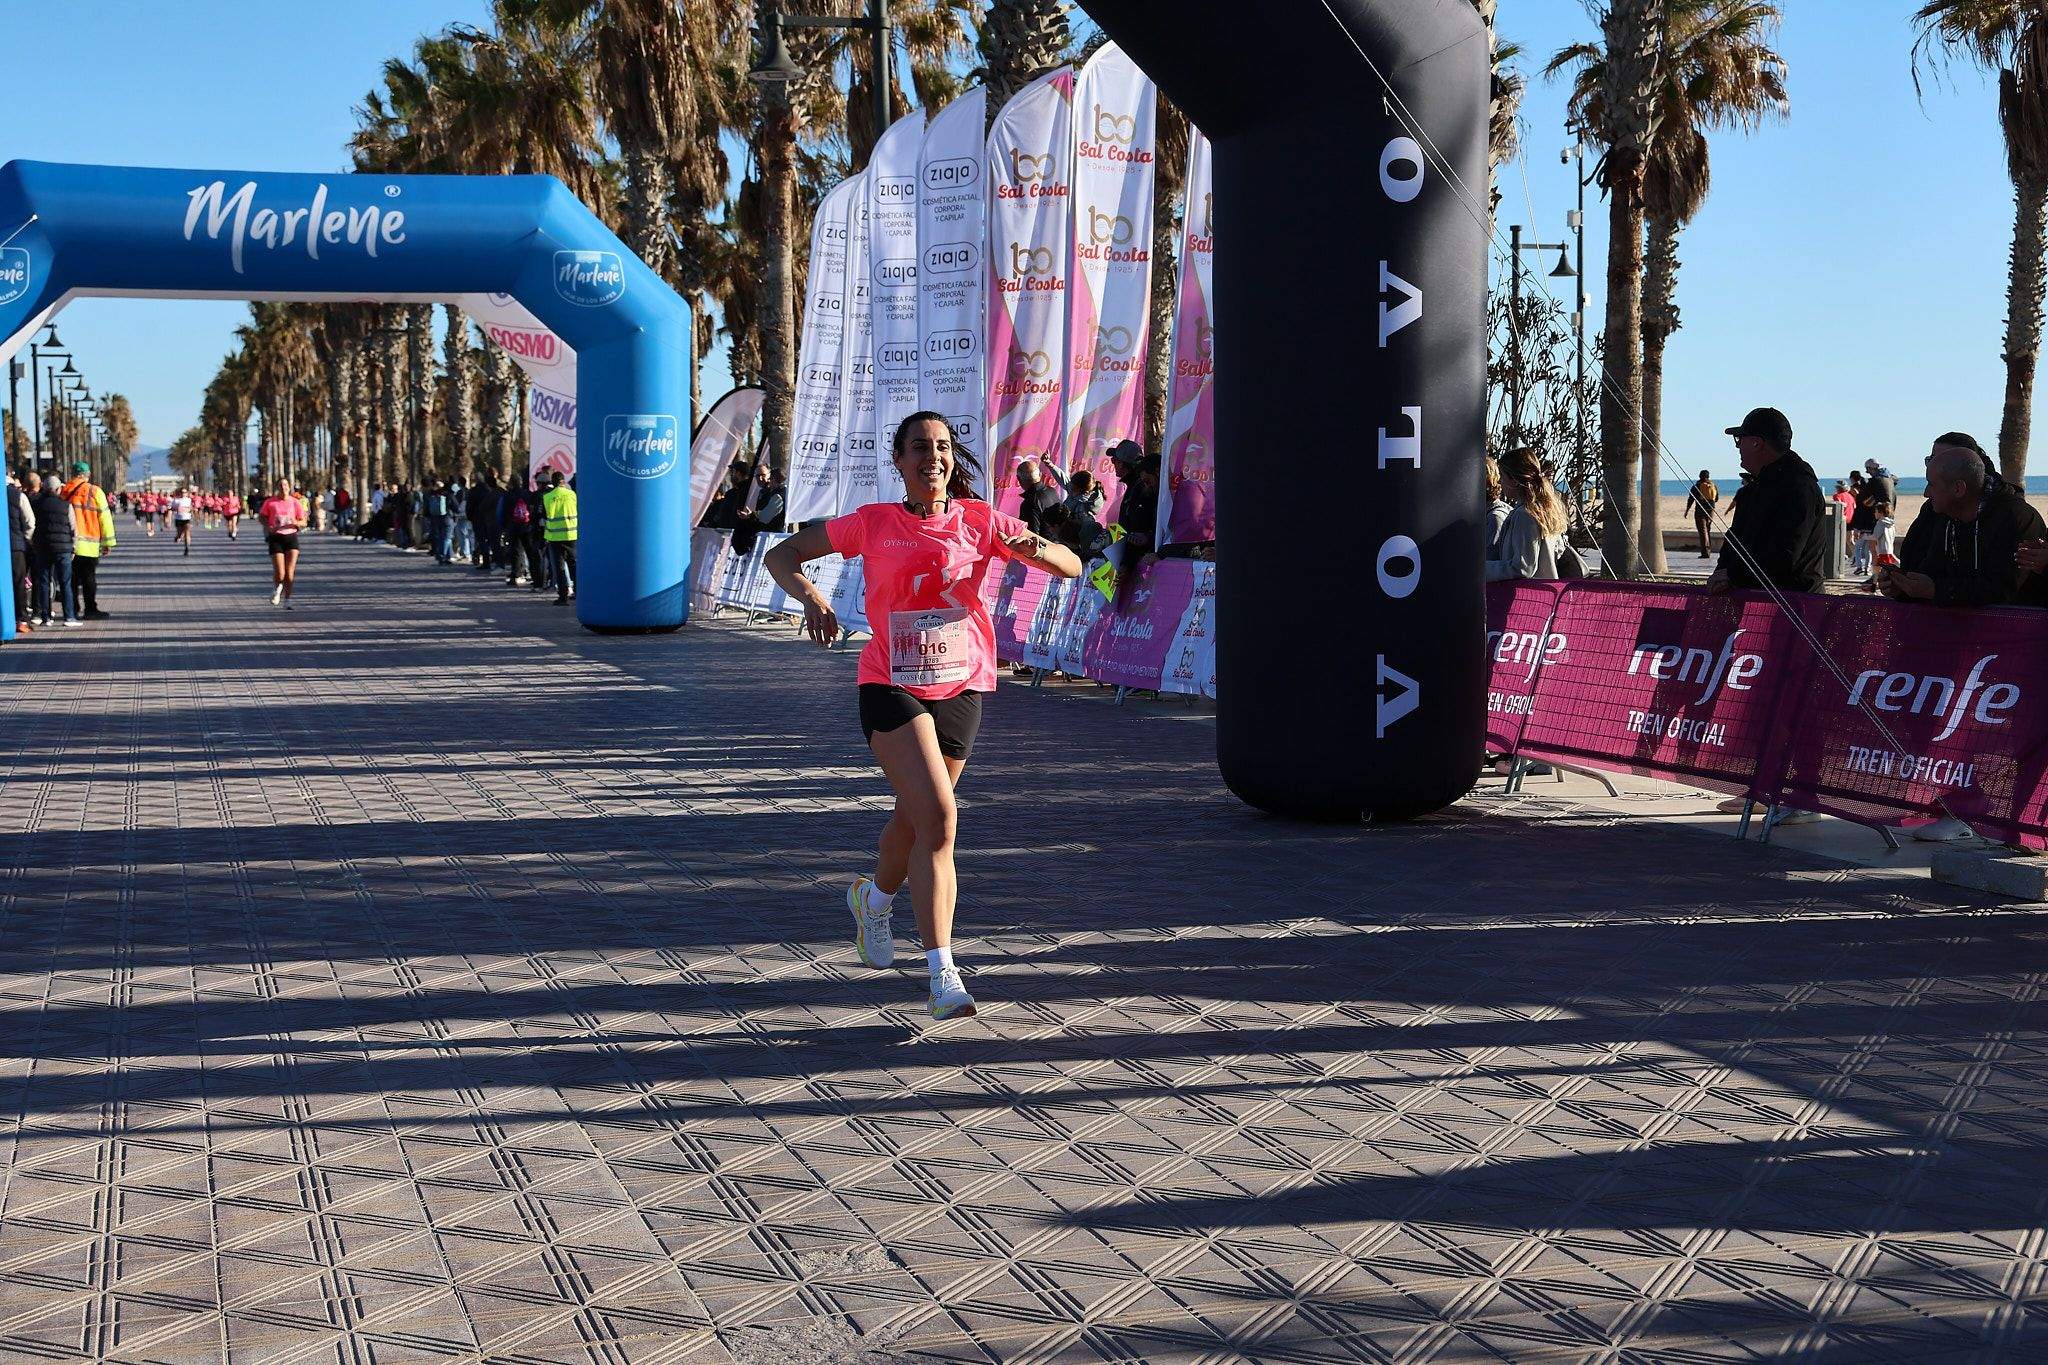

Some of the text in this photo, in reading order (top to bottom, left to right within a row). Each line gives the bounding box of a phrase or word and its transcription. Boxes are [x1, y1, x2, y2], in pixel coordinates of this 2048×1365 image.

[1079, 142, 1153, 164] Sal Costa
[931, 165, 969, 183] ziaja
[880, 184, 914, 200] ziaja
[998, 181, 1070, 199] Sal Costa
[934, 204, 966, 213] CORPORAL
[940, 213, 964, 222] CAPILAR
[183, 180, 406, 275] Marlene
[1187, 233, 1213, 253] Sal
[931, 250, 969, 267] ziaja
[1077, 243, 1150, 262] Sal Costa
[559, 263, 620, 291] Marlene
[882, 266, 917, 283] ziaja
[997, 276, 1066, 292] Sal Costa
[933, 290, 965, 299] CORPORAL
[491, 327, 555, 361] COSMO
[931, 337, 970, 354] ziaja
[994, 379, 1062, 396] Sal Costa
[608, 429, 674, 461] Marlene
[1376, 136, 1425, 738] VOLVO
[802, 440, 838, 456] ziaja
[883, 539, 918, 548] OYSHO
[1111, 615, 1127, 637] Sal
[1127, 616, 1154, 640] Costa
[919, 641, 947, 656] 016
[1487, 612, 1567, 683] renfe
[1627, 628, 1763, 706] renfe
[1847, 654, 2021, 742] renfe
[1626, 710, 1726, 747] TREN OFICIAL
[1846, 745, 1976, 788] TREN OFICIAL
